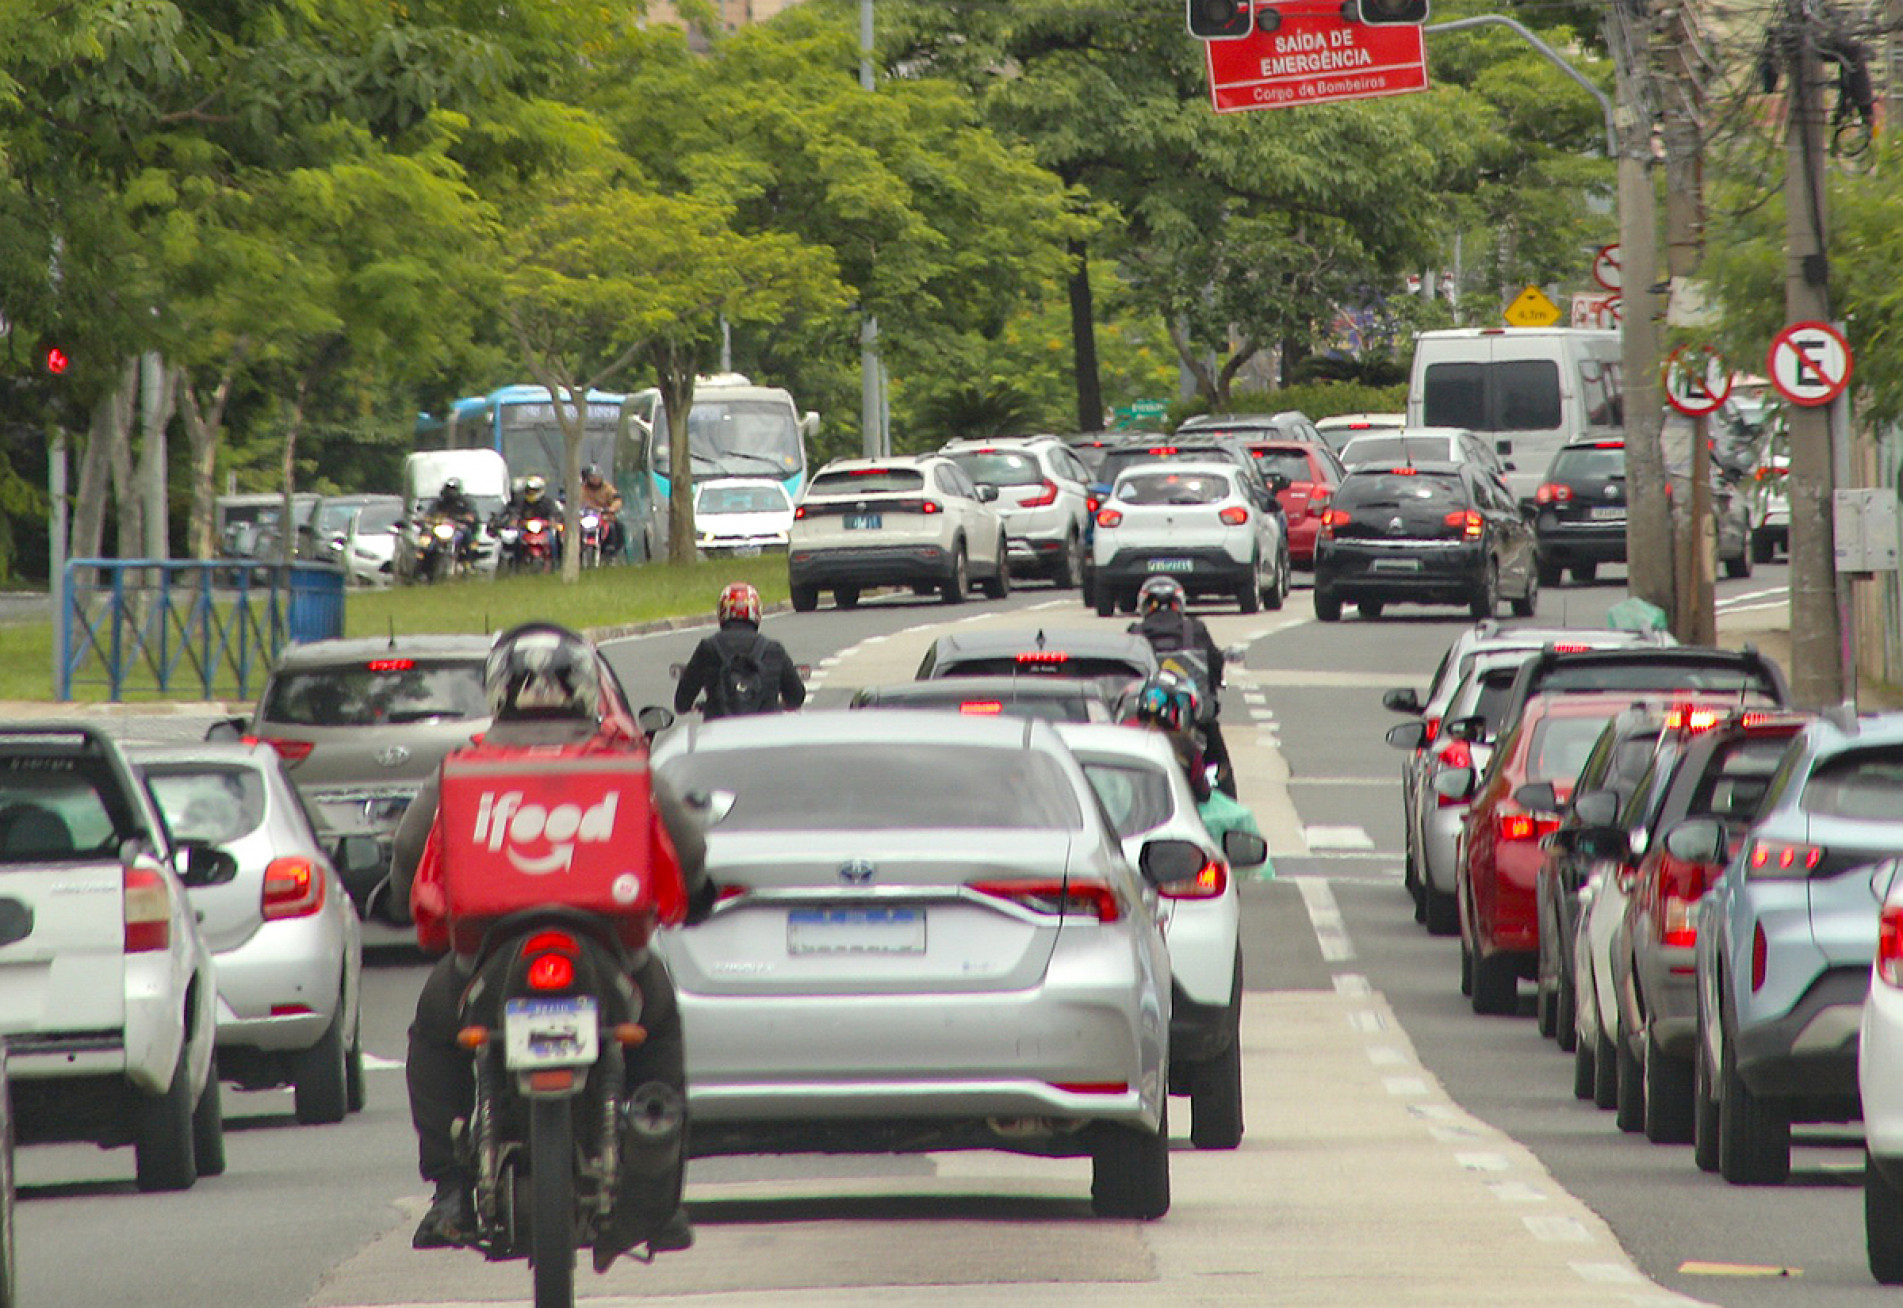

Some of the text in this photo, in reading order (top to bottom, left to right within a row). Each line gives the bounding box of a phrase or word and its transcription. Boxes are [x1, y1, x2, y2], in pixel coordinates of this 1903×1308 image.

[1275, 28, 1353, 53] SAÍDA DE
[1260, 48, 1372, 77] EMERGÊNCIA
[1253, 75, 1386, 101] Corpo de Bombeiros
[1797, 340, 1825, 386] E
